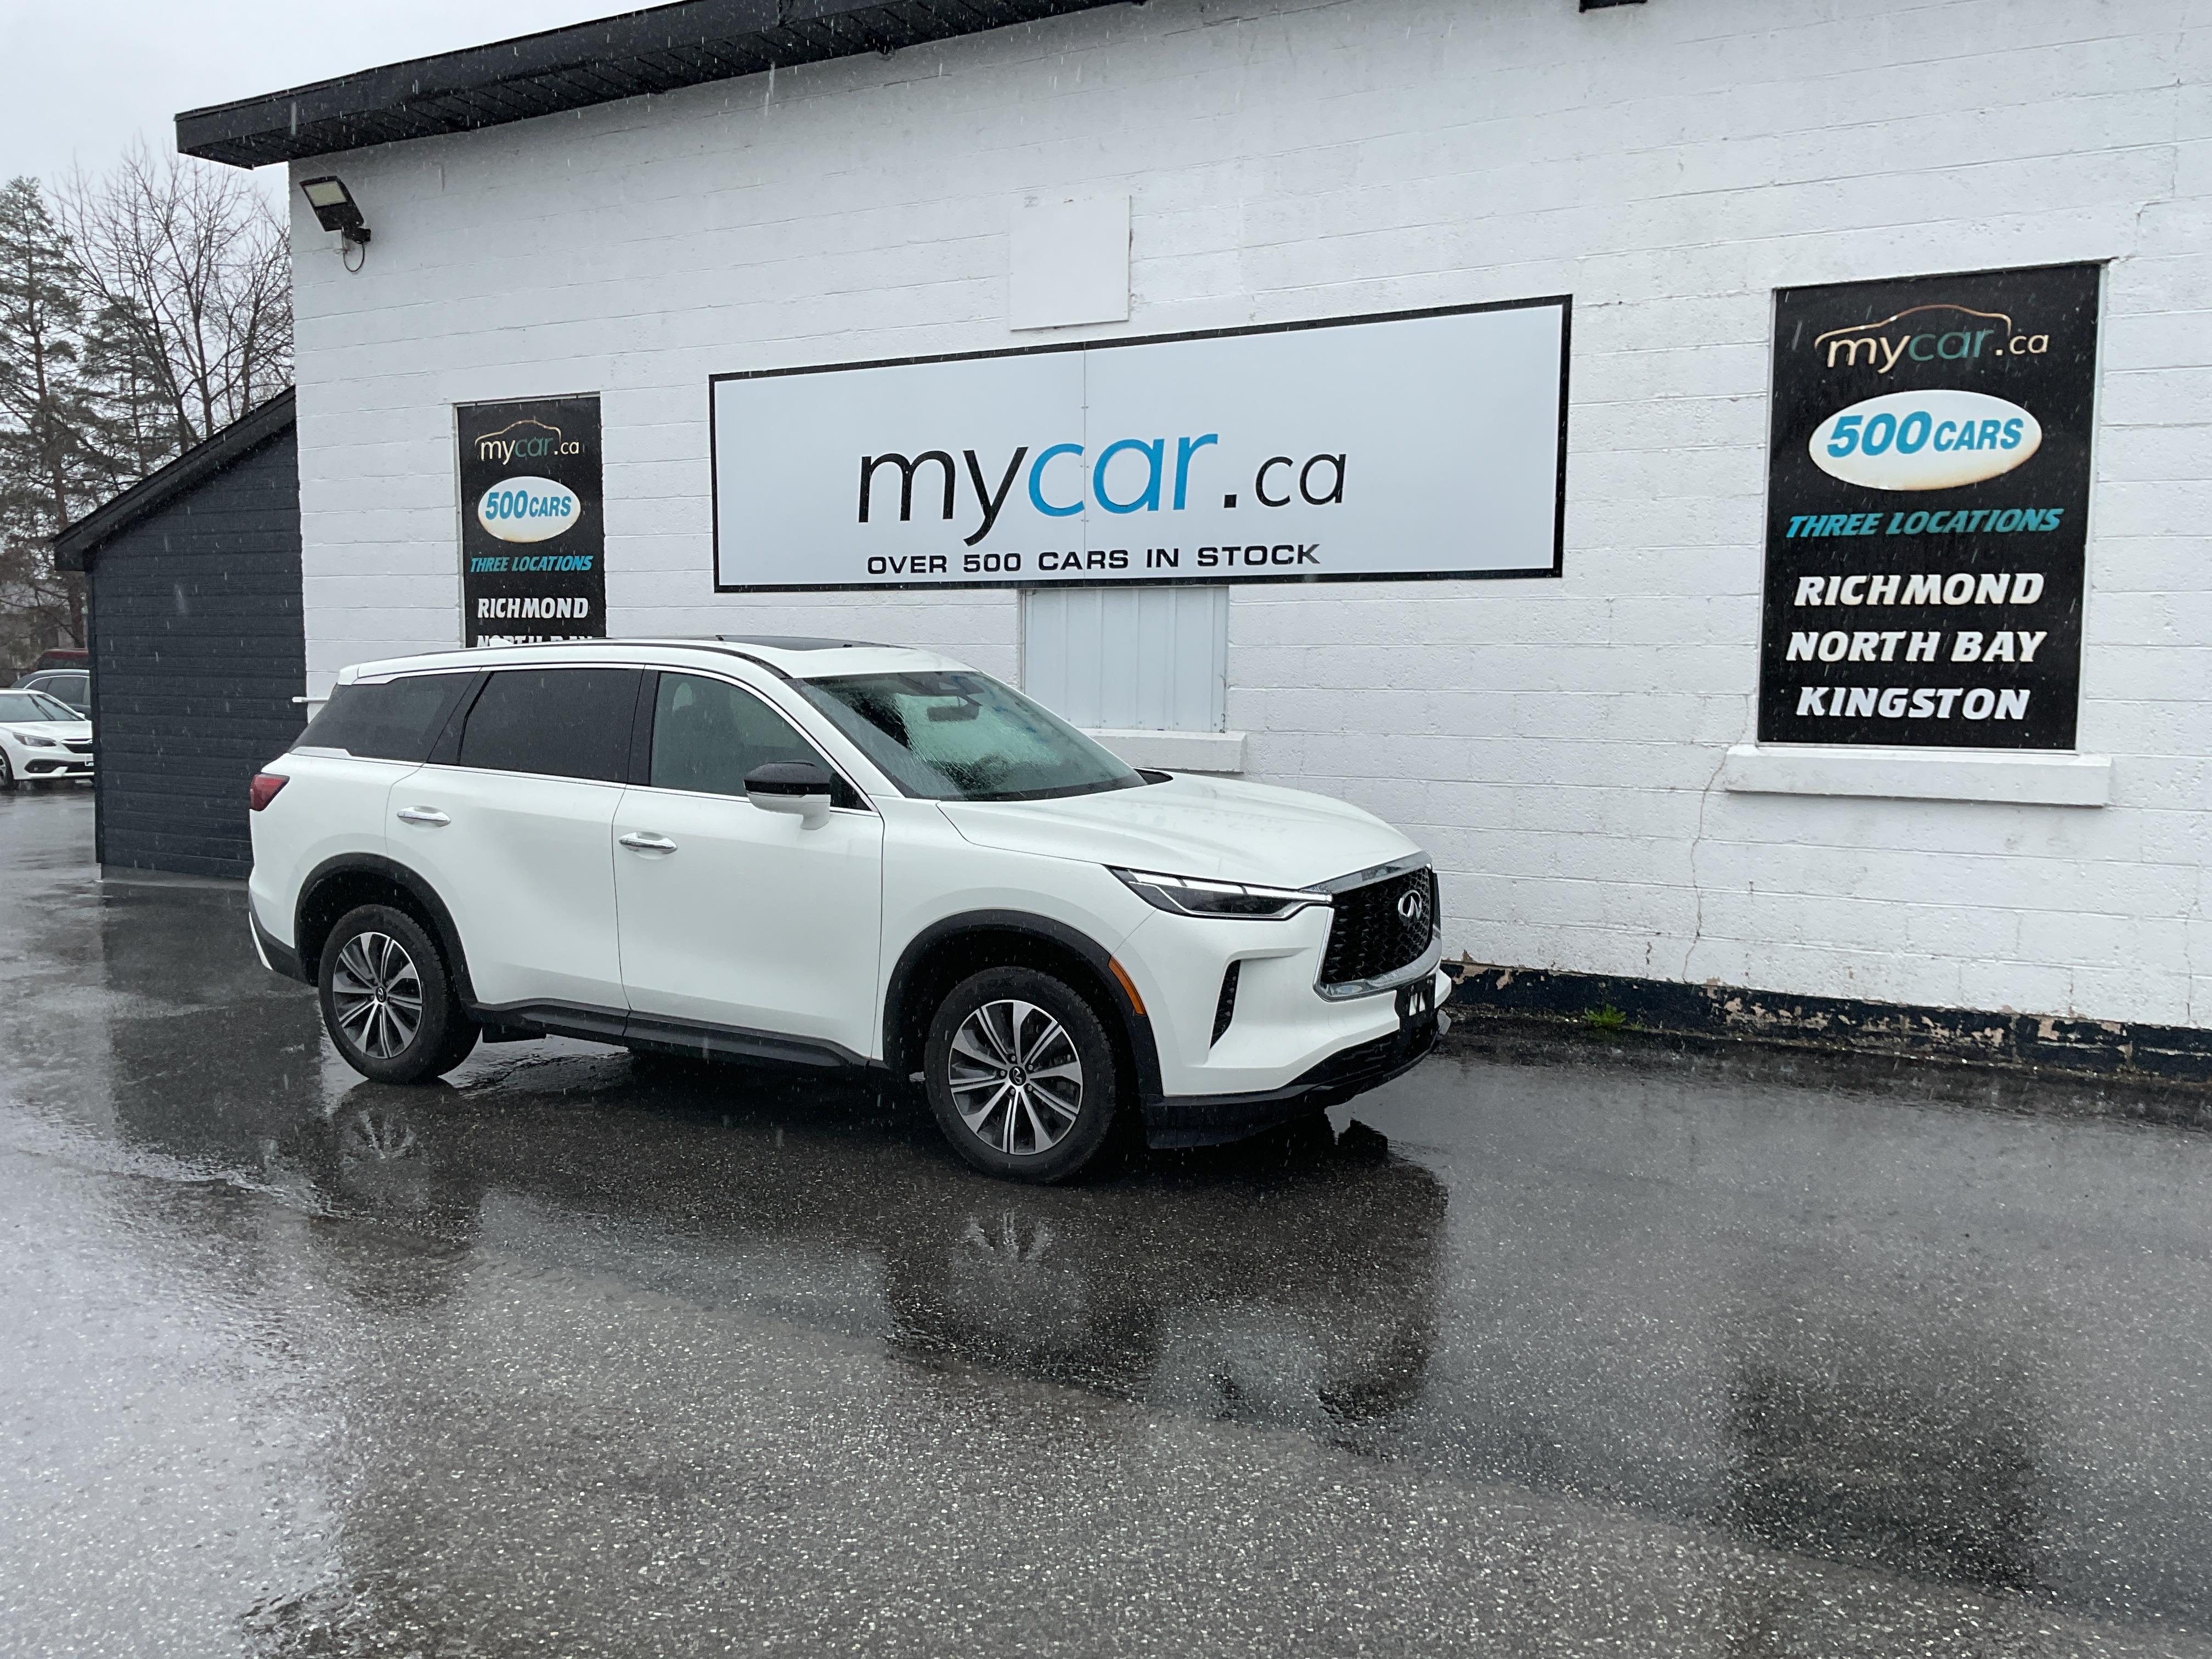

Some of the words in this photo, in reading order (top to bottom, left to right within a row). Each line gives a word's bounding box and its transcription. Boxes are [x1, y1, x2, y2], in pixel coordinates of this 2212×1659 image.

[1786, 512, 1883, 538] THREE
[1886, 508, 2064, 535] LOCATIONS
[470, 556, 509, 573] THREE
[511, 555, 593, 572] LOCATIONS
[867, 555, 947, 574] OVER
[963, 553, 1021, 572] 500
[1039, 550, 1128, 571] CARS
[1146, 548, 1179, 568] IN
[1197, 544, 1321, 566] STOCK
[1794, 573, 2045, 606] RICHMOND
[477, 597, 589, 619] RICHMOND
[1786, 631, 1940, 662] NORTH
[1950, 631, 2047, 662] BAY
[1796, 686, 2030, 720] KINGSTON
